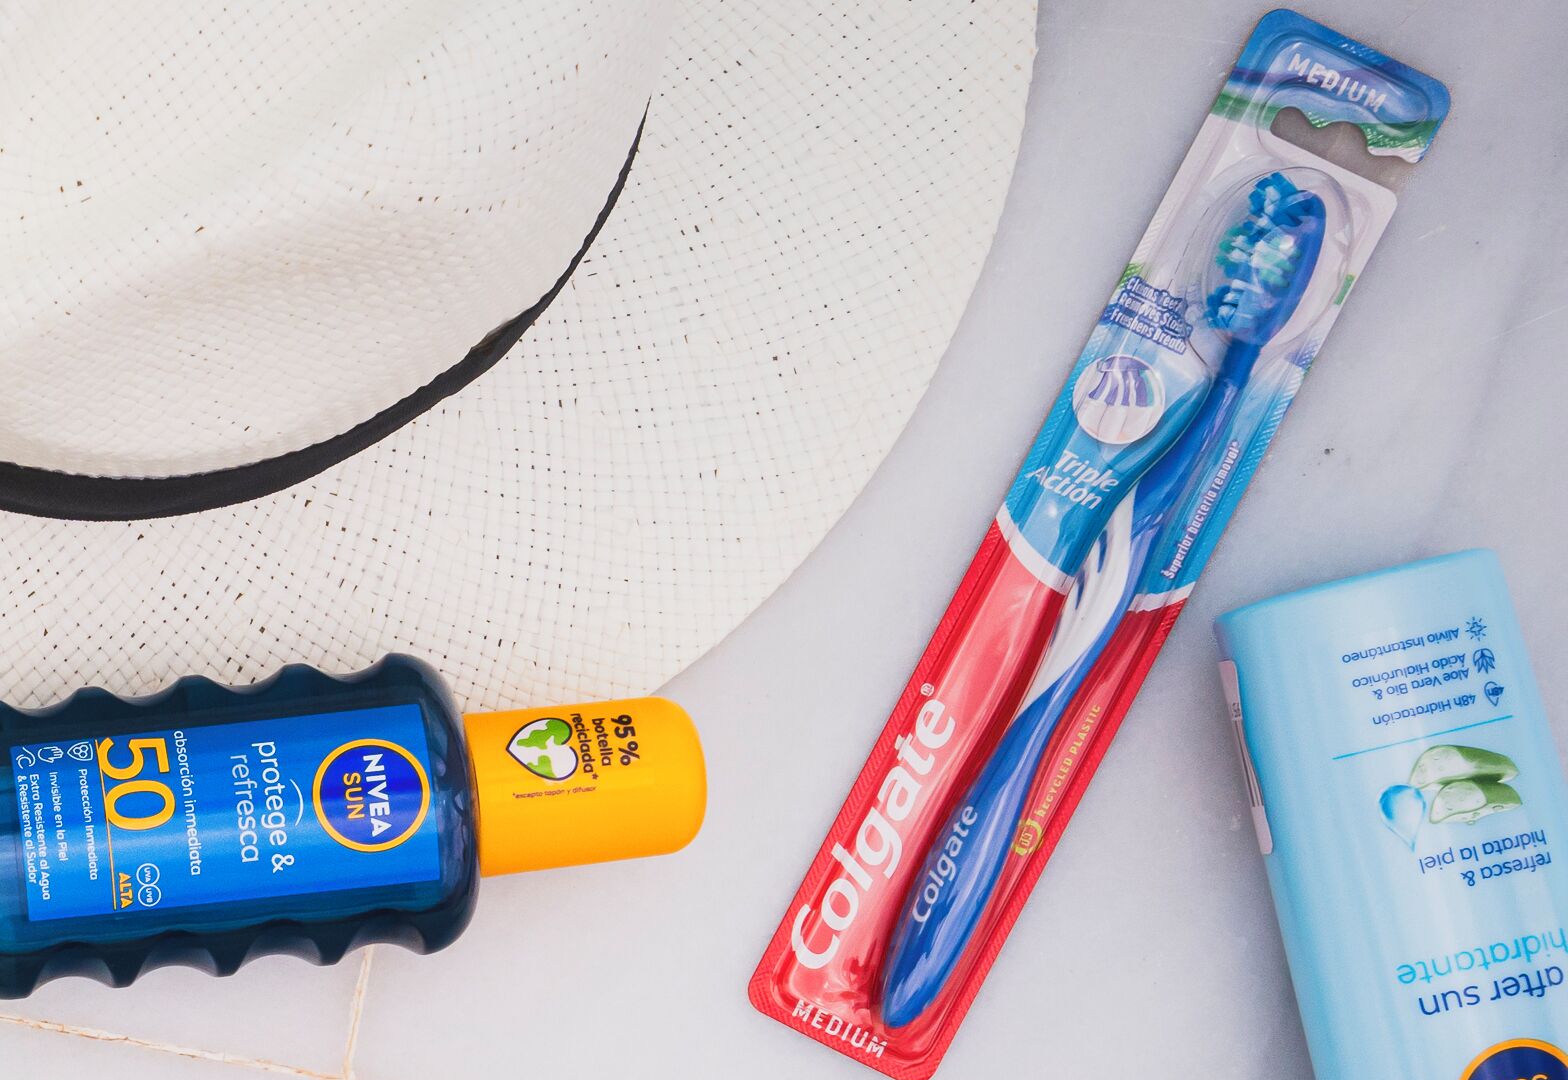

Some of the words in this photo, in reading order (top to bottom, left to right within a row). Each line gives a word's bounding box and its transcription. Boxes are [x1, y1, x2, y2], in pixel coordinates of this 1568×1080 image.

[1287, 53, 1388, 112] MEDIUM
[1026, 465, 1108, 515] Action
[1054, 447, 1120, 501] Triple
[1161, 533, 1194, 579] Superior
[1187, 486, 1217, 536] bacteria
[1341, 636, 1425, 663] Instantáneo
[1427, 628, 1459, 644] Alivio
[1352, 661, 1430, 688] Hialurónico
[1431, 653, 1469, 674] Ácido
[1372, 698, 1453, 725] Hidratación
[1453, 694, 1476, 707] 48h
[591, 718, 613, 766] botella
[1034, 758, 1073, 817] RECYCLED
[1068, 705, 1100, 755] PLASTIC
[49, 772, 62, 812] Invisible
[78, 768, 93, 823] Protección
[94, 737, 176, 836] 50
[173, 729, 195, 797] absorción
[184, 800, 202, 875] inmediata
[251, 741, 294, 846] protege
[343, 772, 365, 820] SUN
[363, 754, 391, 837] NIVEA
[55, 814, 63, 828] en
[230, 755, 262, 863] refresca
[56, 828, 66, 839] la
[58, 838, 69, 861] Piel
[82, 822, 100, 881] Inmediata
[1481, 830, 1547, 855] hidrata
[271, 853, 295, 873] &
[912, 804, 977, 924] Colgate
[1419, 847, 1455, 874] piel
[1459, 846, 1479, 862] la
[1480, 852, 1552, 879] refresca
[119, 872, 133, 908] ALTA
[1460, 870, 1476, 887] &
[1396, 927, 1568, 985] hidratante
[1418, 985, 1481, 1015] sun
[1490, 966, 1564, 1001] after
[792, 995, 887, 1058] MEDIUM
